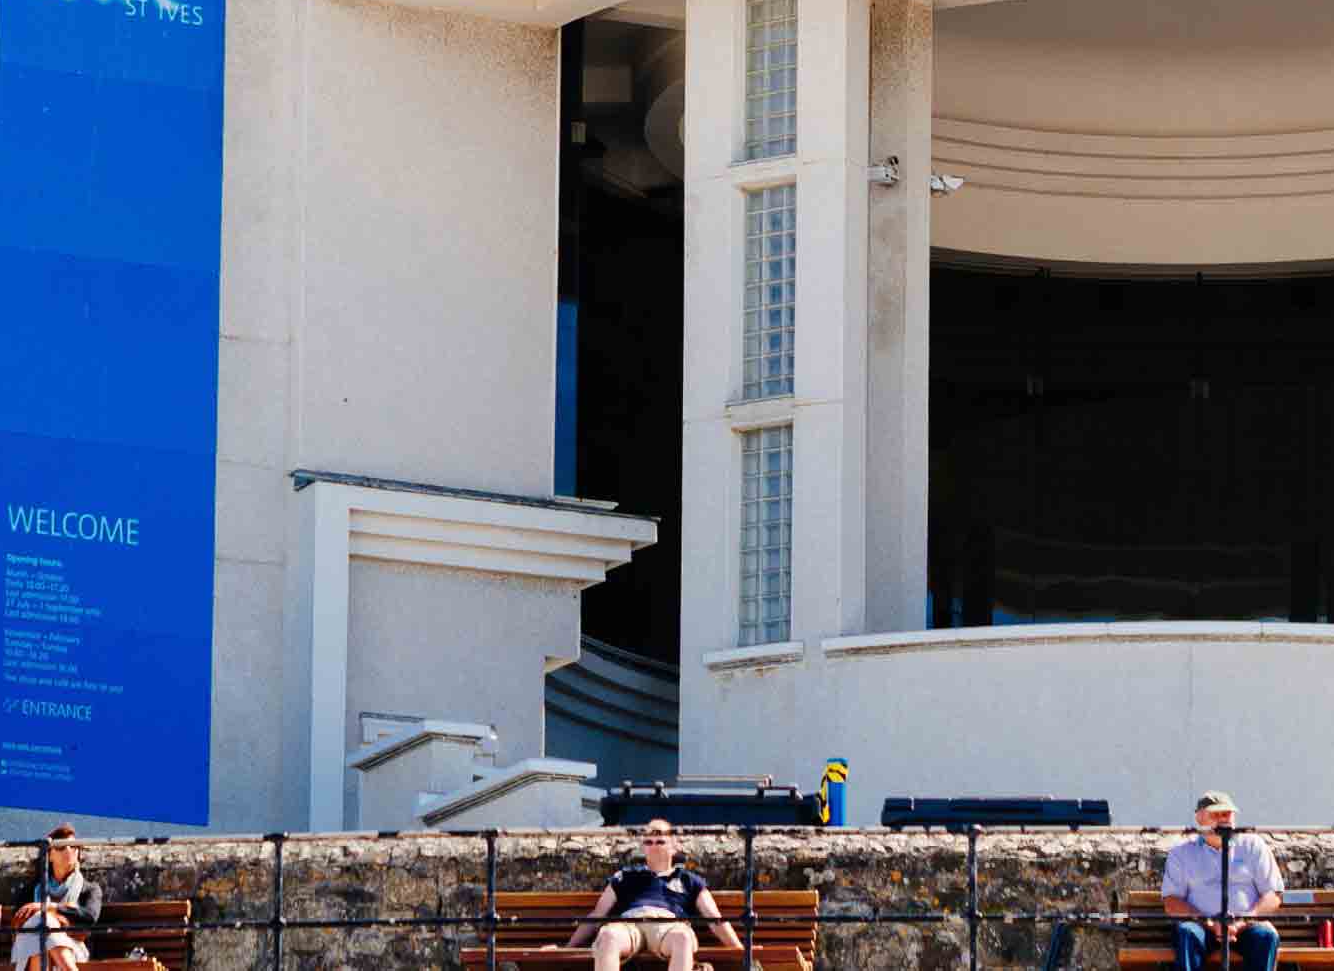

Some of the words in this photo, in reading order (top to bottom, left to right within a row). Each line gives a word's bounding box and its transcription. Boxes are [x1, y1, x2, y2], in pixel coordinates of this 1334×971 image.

[159, 5, 204, 26] IVES
[7, 503, 140, 546] WELCOME
[22, 699, 92, 722] ENTRANCE
